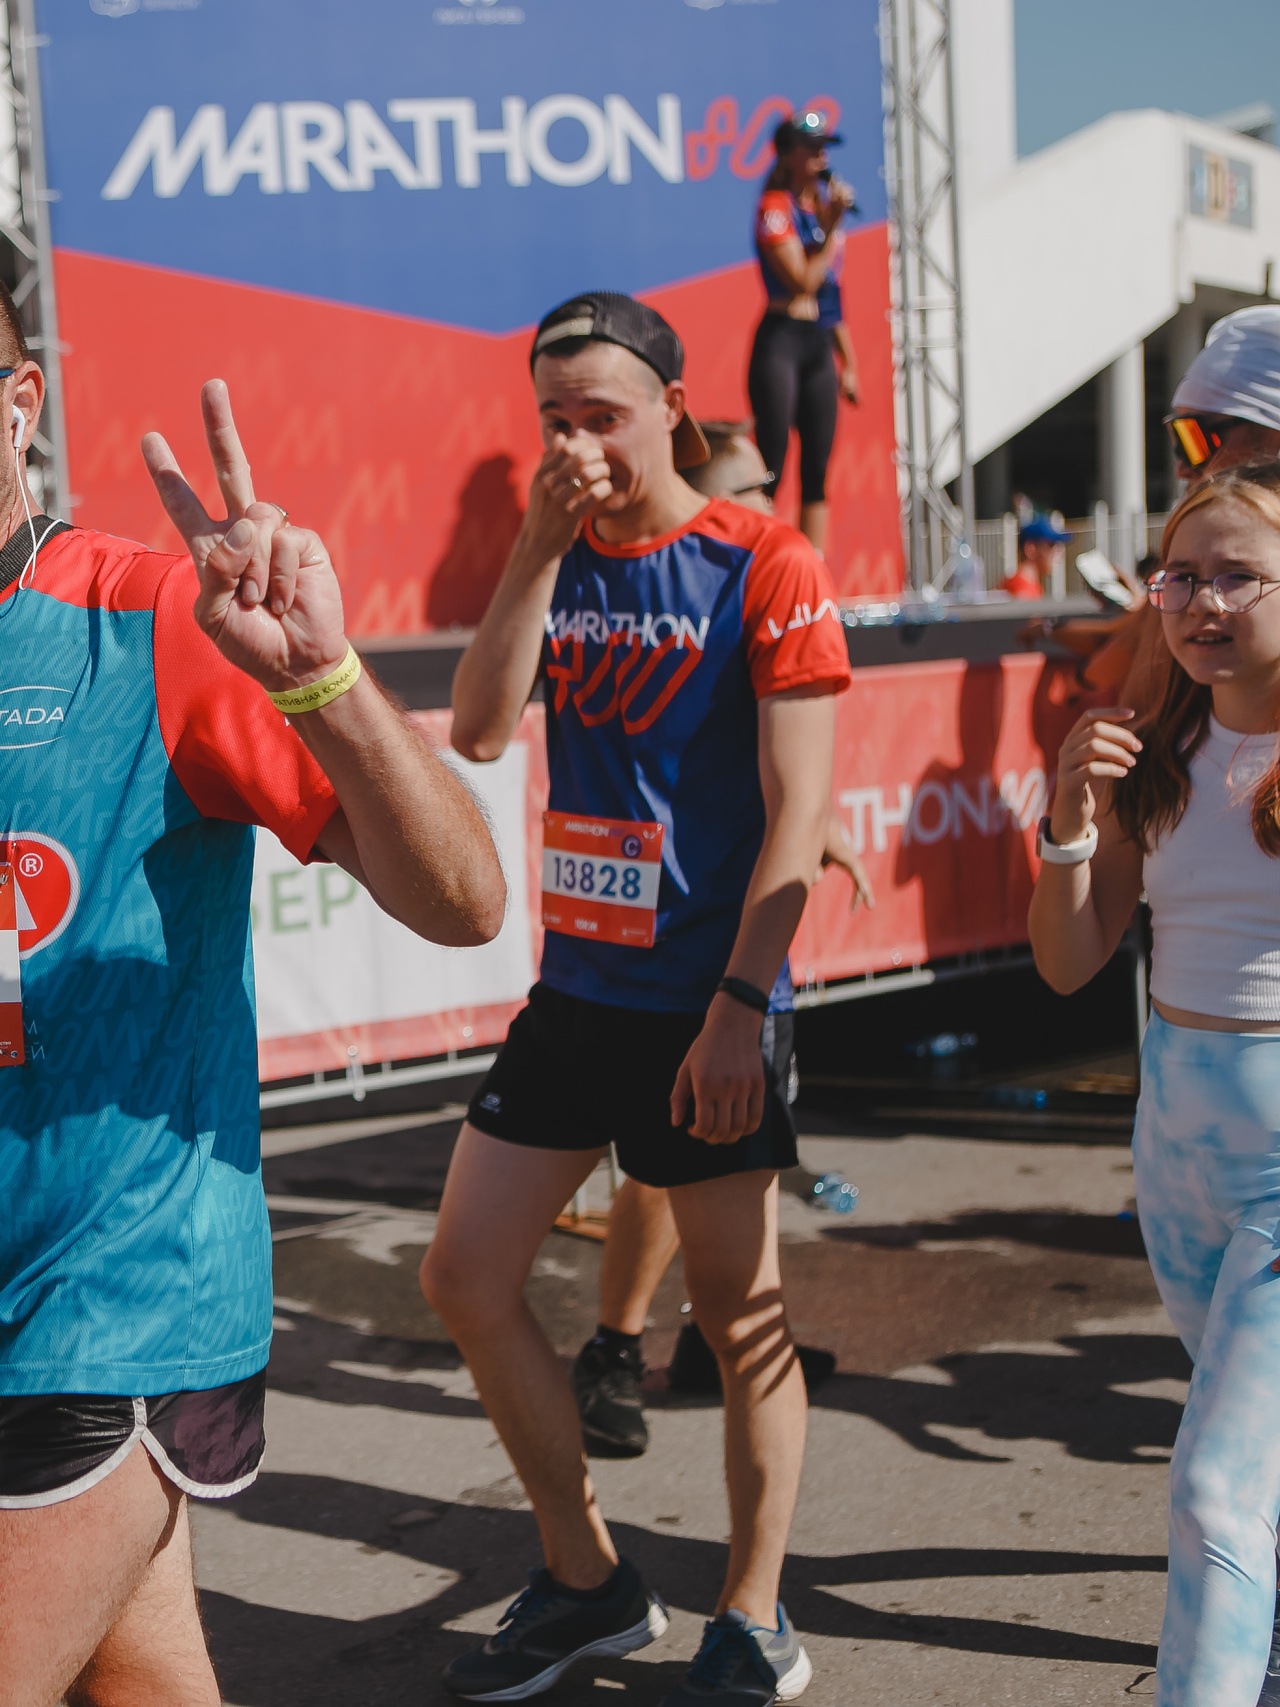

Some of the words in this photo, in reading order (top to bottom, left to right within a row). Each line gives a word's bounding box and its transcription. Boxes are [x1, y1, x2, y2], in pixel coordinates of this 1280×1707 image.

[101, 93, 685, 200] MARATHON
[839, 776, 991, 856] THON
[554, 856, 642, 901] 13828
